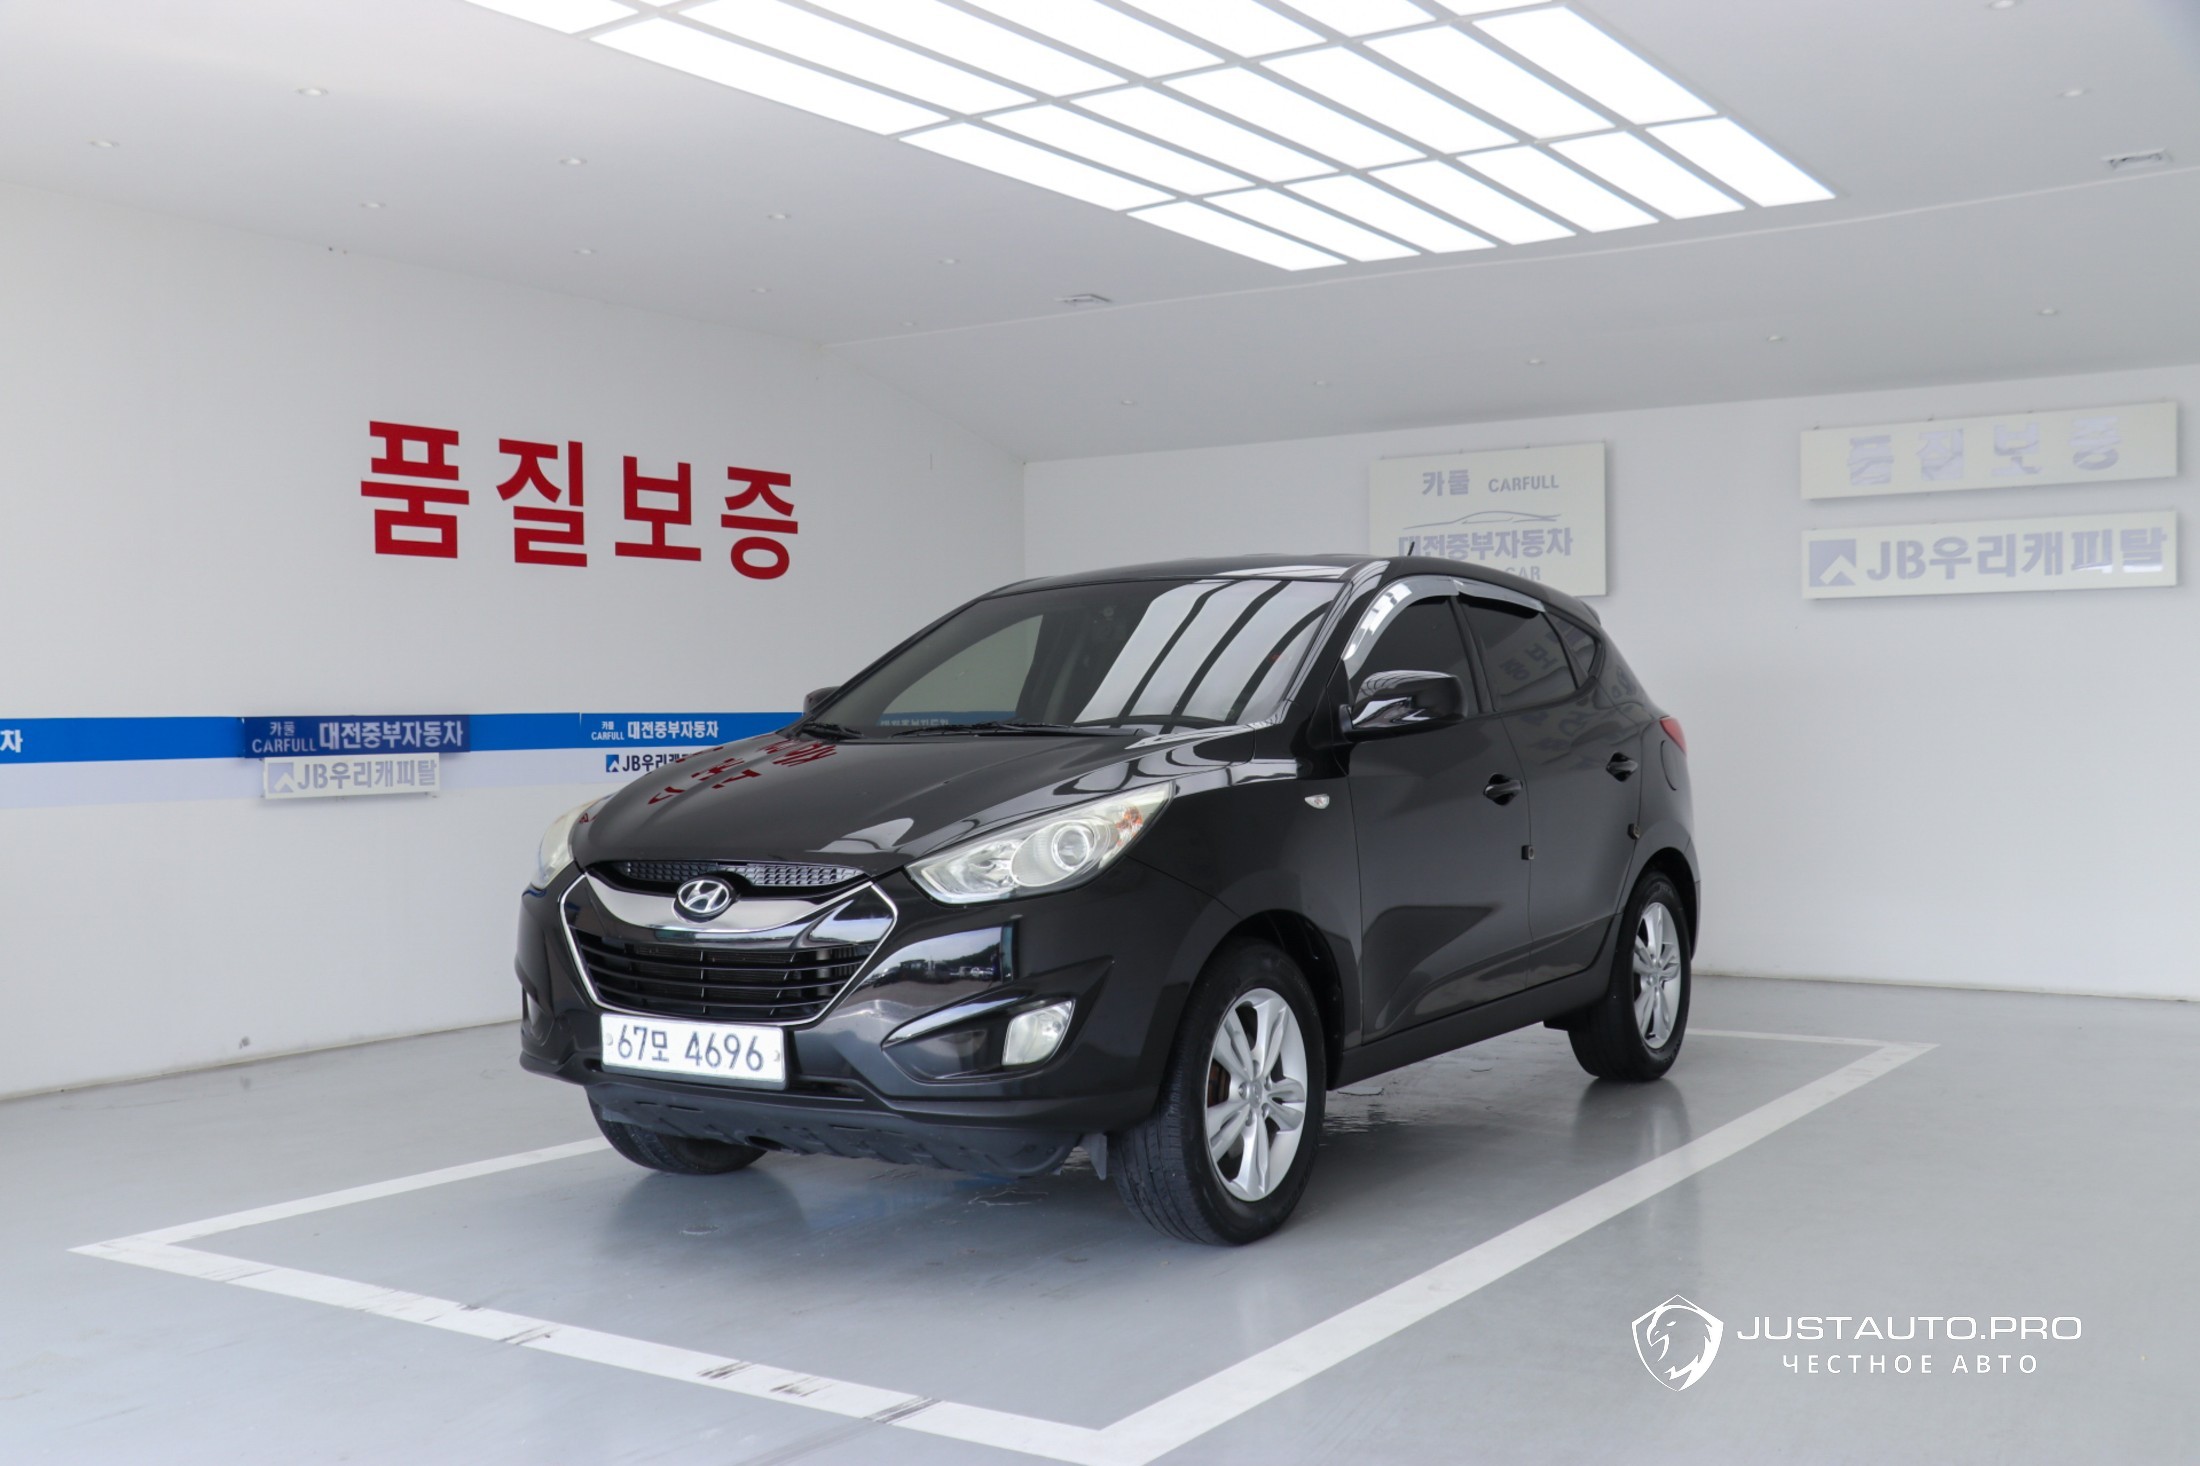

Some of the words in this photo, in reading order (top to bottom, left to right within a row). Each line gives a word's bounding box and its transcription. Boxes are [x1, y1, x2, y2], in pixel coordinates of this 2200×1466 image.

[1488, 474, 1559, 493] CARFULL
[361, 420, 798, 580] 품질보증
[1866, 526, 2167, 582] JB우리캐피탈
[319, 720, 463, 750] 대전중부자동차
[627, 720, 719, 740] 대전중부자동차
[252, 738, 317, 754] CARFULL
[297, 759, 437, 790] JB우리캐피탈
[617, 1023, 670, 1063] 67모
[684, 1030, 764, 1072] 4696
